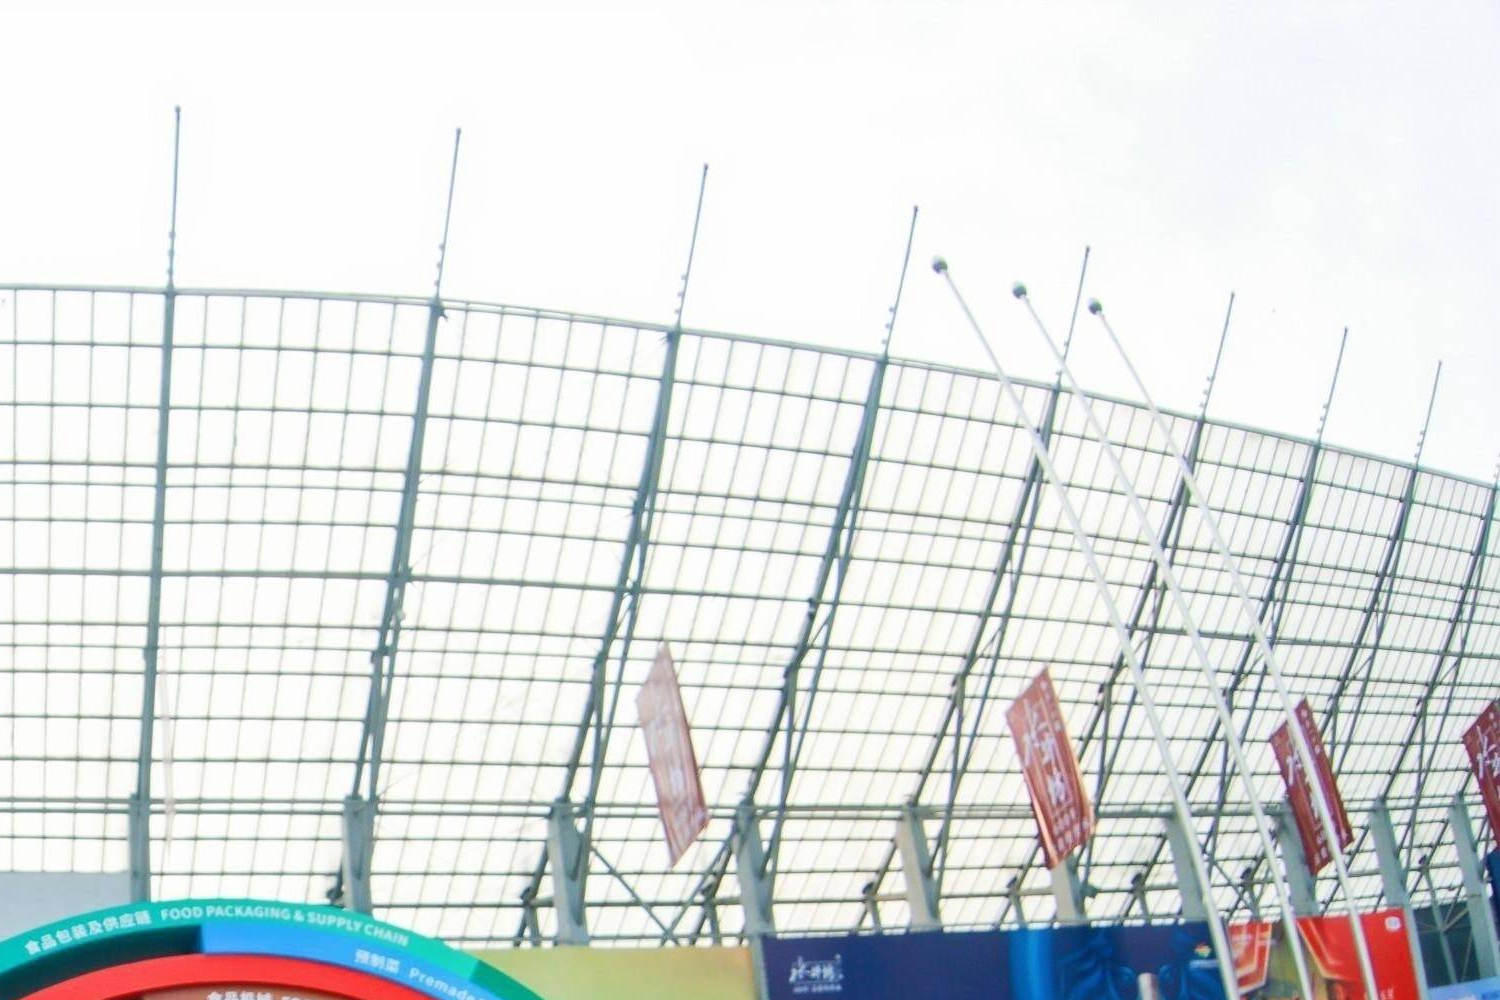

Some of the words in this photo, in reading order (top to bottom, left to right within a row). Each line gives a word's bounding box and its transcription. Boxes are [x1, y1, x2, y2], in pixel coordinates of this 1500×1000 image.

[160, 906, 203, 922] FOOD
[206, 904, 290, 921] PACKAGING
[293, 909, 305, 922] &
[307, 910, 362, 933] SUPPLY
[364, 921, 409, 946] CHAIN
